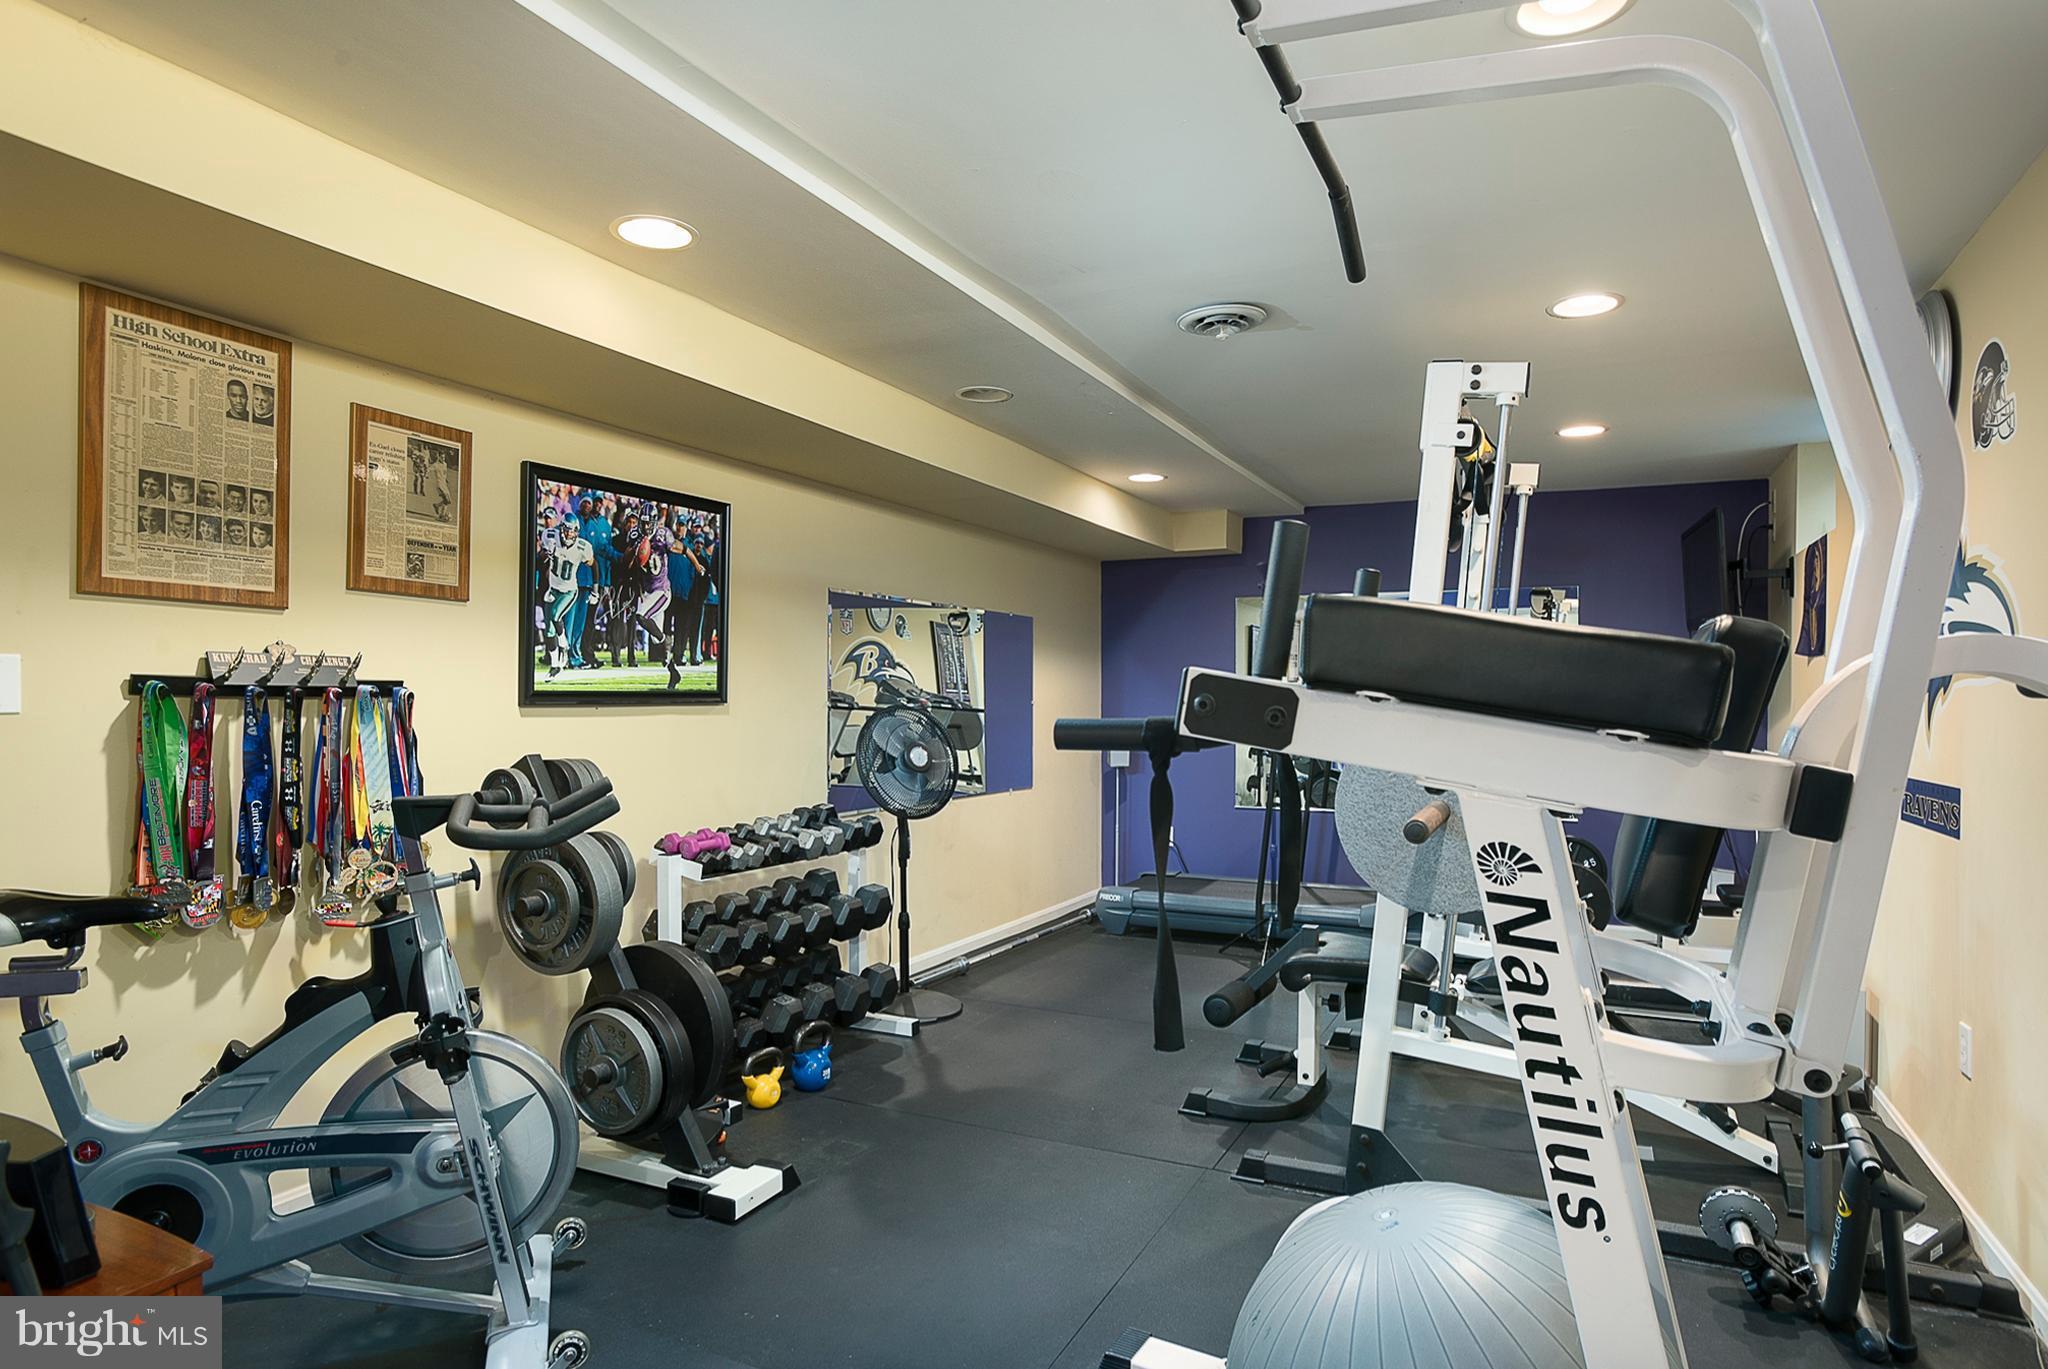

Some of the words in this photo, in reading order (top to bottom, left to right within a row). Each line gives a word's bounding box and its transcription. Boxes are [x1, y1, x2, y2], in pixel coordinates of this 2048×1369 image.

[113, 314, 158, 337] High
[162, 328, 218, 353] School
[219, 342, 266, 366] Extra
[178, 350, 207, 363] Malone
[209, 358, 226, 368] close
[228, 362, 255, 376] glorious
[257, 371, 272, 380] eras
[550, 555, 573, 581] 10
[1903, 791, 1961, 830] RAVENS
[1583, 857, 1597, 869] 25
[1486, 890, 1606, 1233] Nautilus
[467, 1136, 511, 1265] SCHWINN
